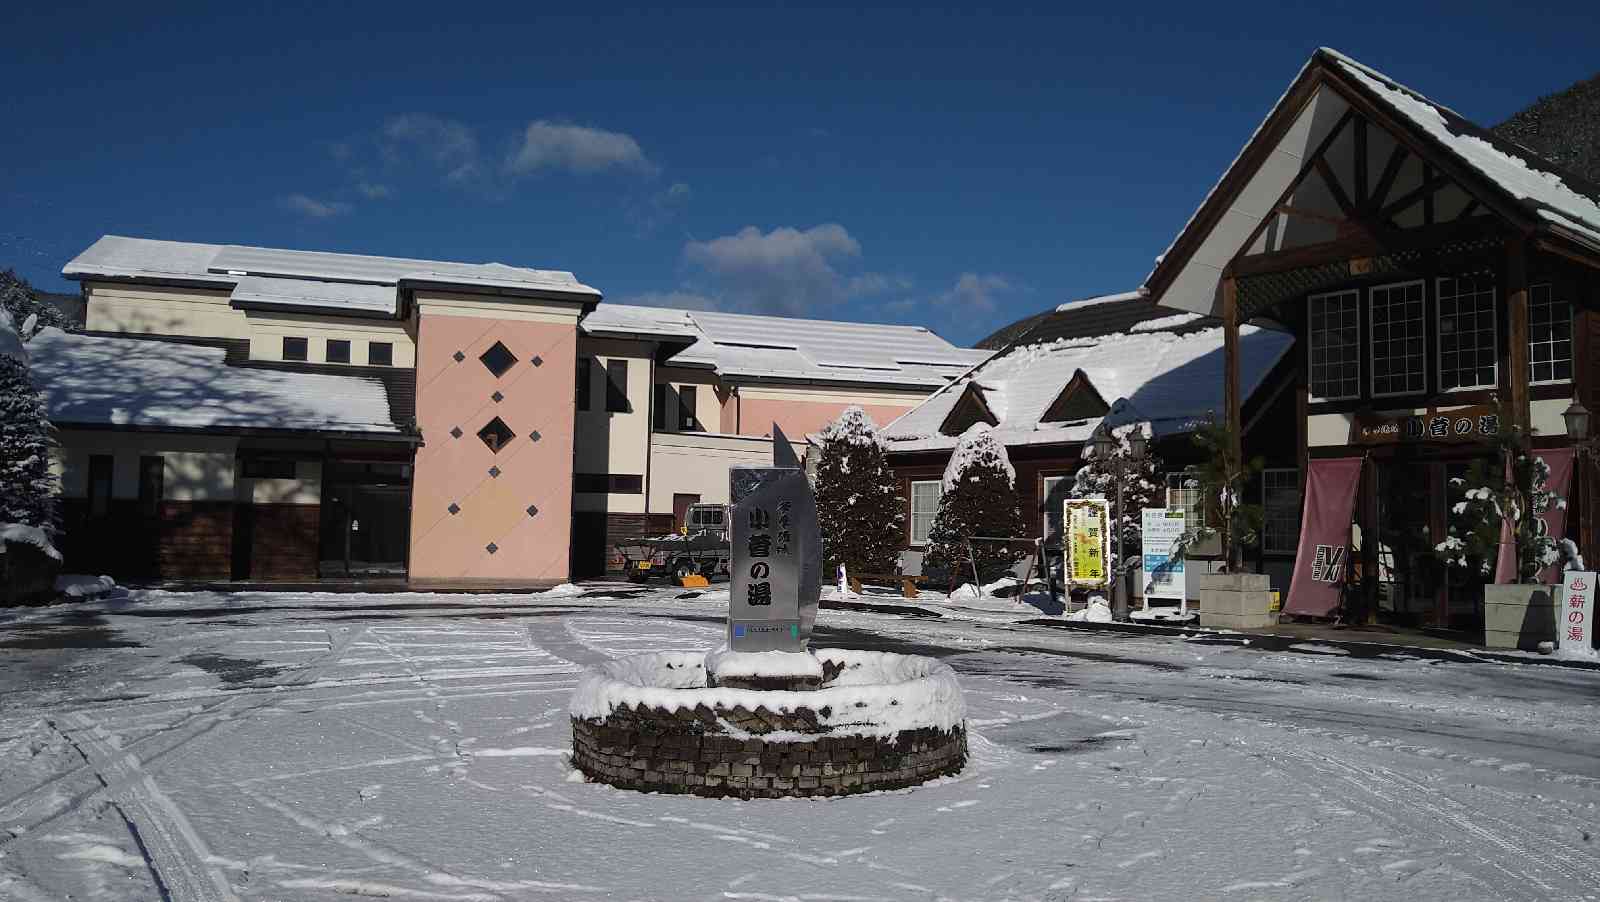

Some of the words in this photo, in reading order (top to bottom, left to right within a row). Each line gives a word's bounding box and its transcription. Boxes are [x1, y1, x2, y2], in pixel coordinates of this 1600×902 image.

[747, 507, 771, 606] 小菅の湯
[1567, 594, 1586, 642] 薪の湯
